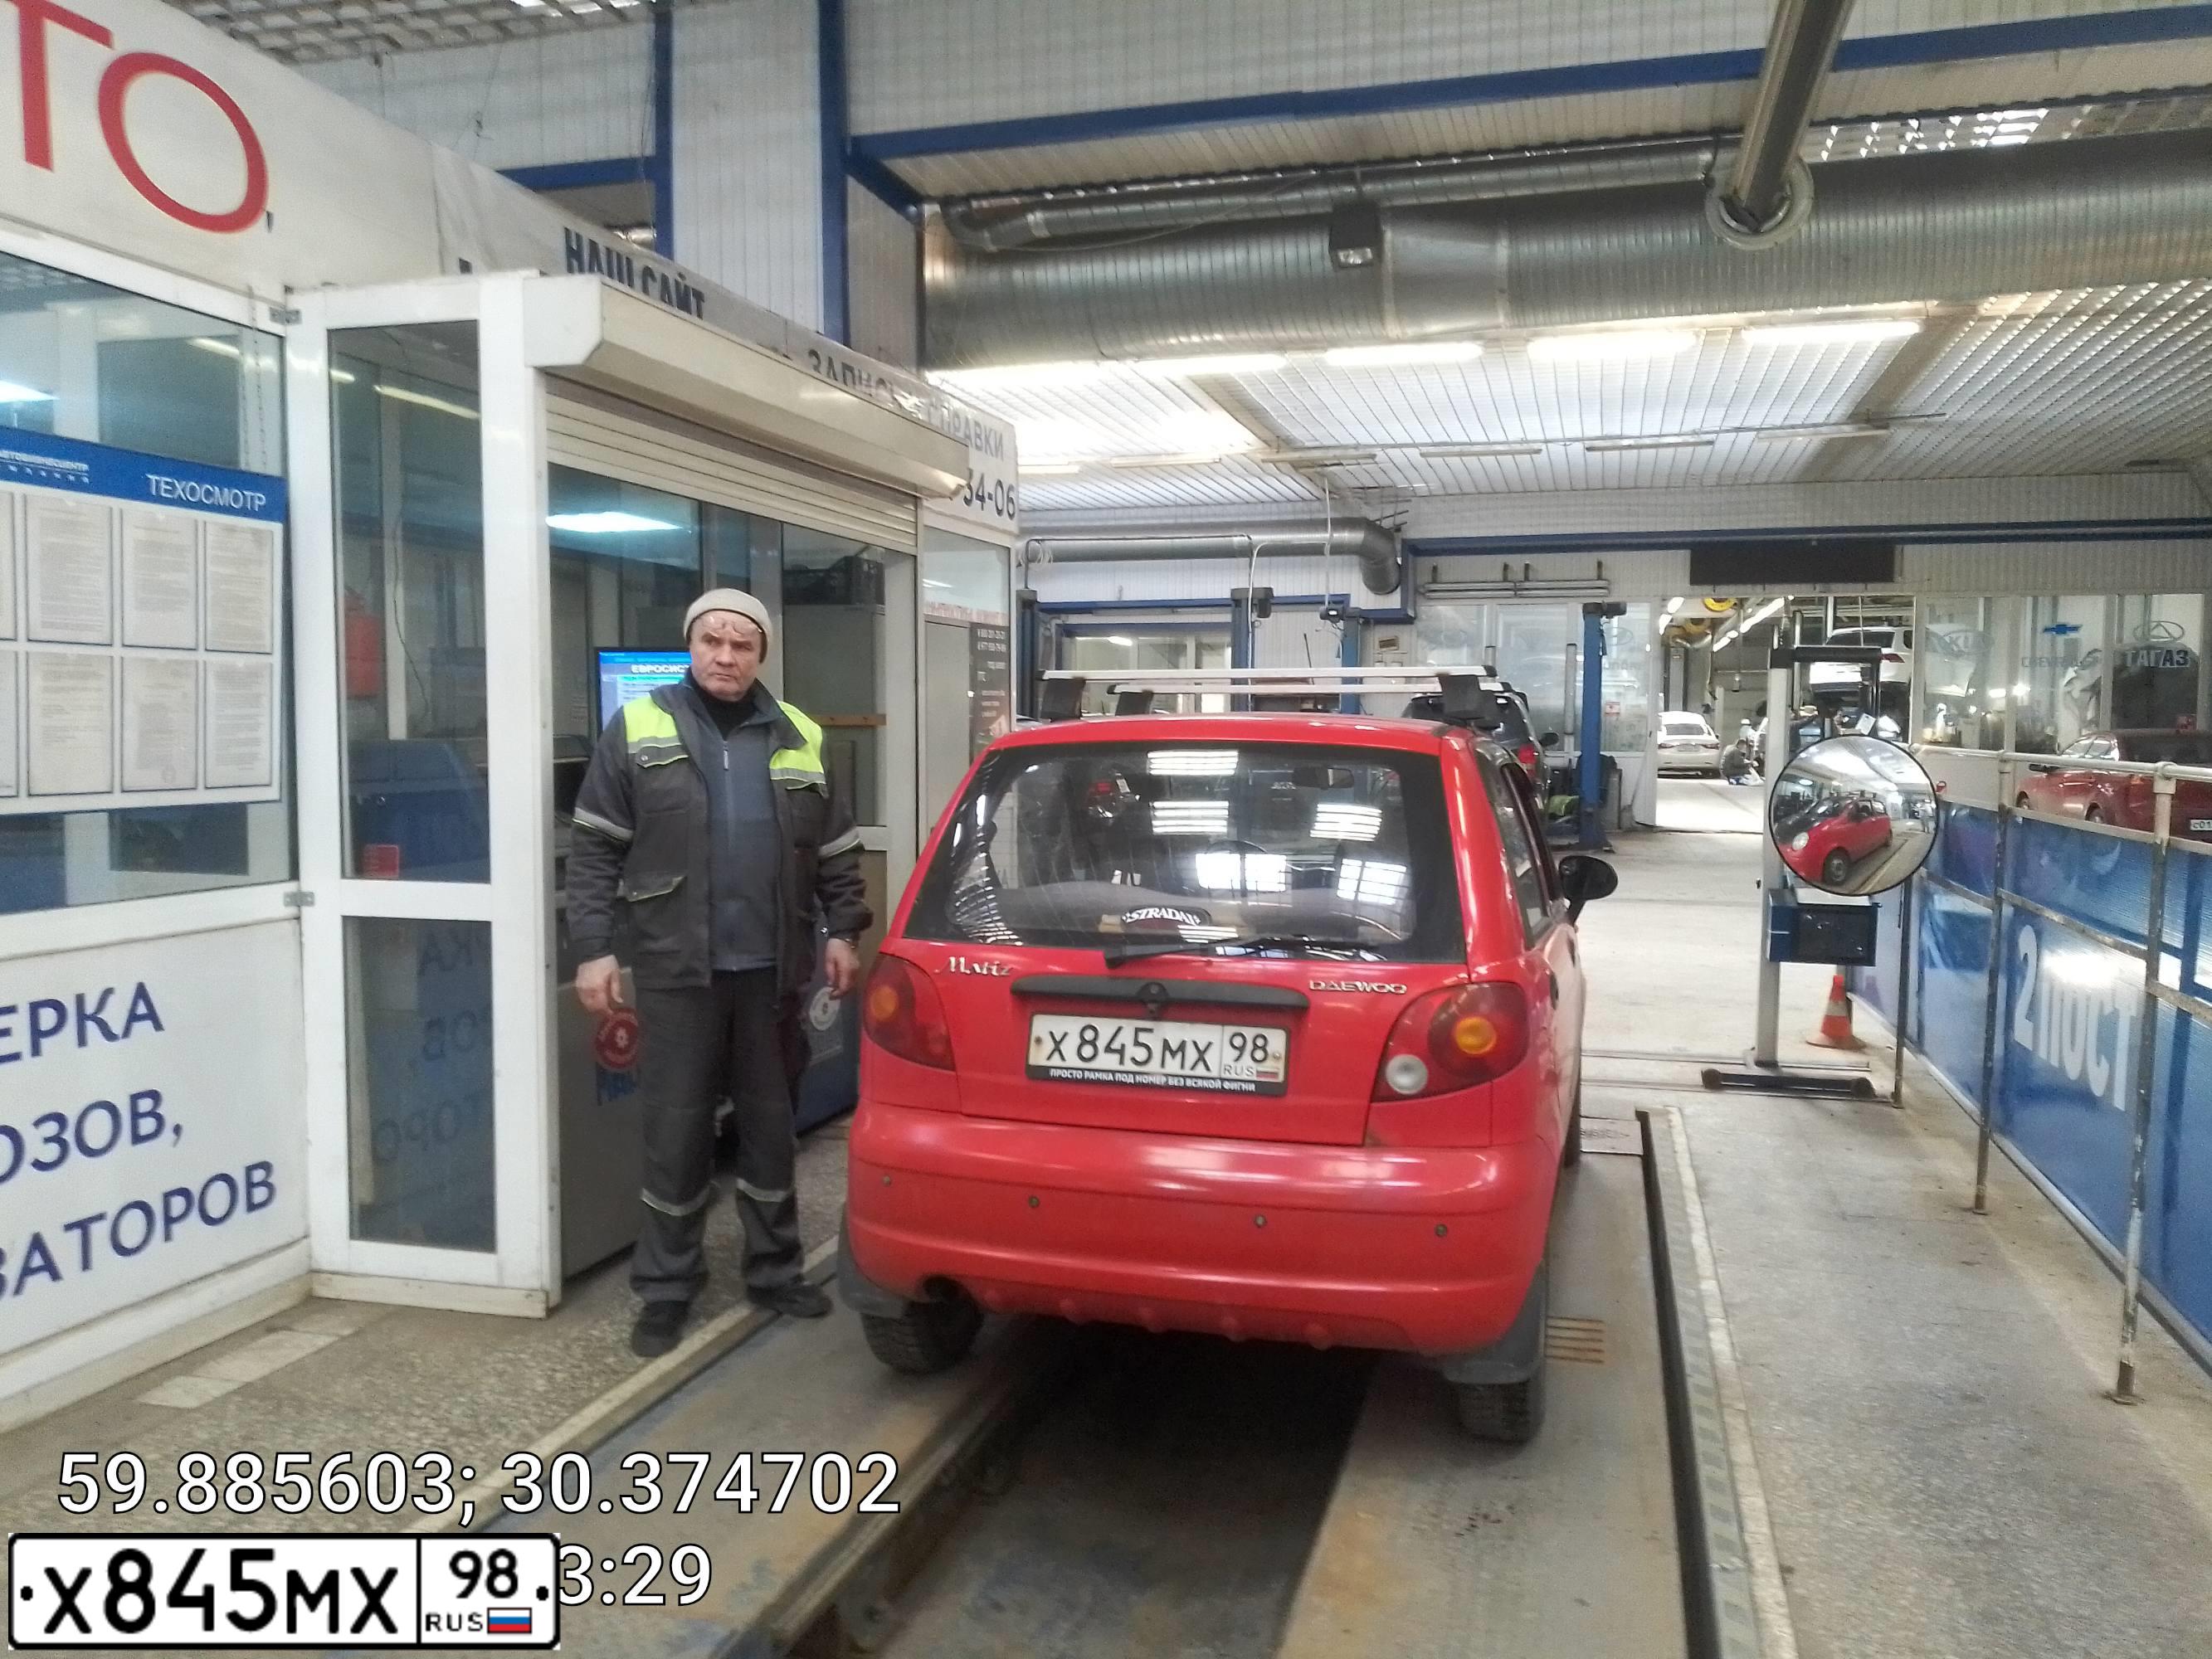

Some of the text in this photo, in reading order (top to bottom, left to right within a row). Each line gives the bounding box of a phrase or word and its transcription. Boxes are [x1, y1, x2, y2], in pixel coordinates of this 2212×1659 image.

[145, 473, 267, 512] ТЕХОСМОТР
[2125, 649, 2191, 669] ТАГАЗ
[1309, 980, 1407, 995] DAEWOO
[1229, 1031, 1269, 1064] 98
[1048, 1068, 1256, 1092] ПРОСТО РАМКА ПОД НОМЕР БЕЗ ВСЯКОЙ ФИГНИ
[1223, 1064, 1255, 1078] RUS
[0, 1160, 277, 1303] АТОРОВ
